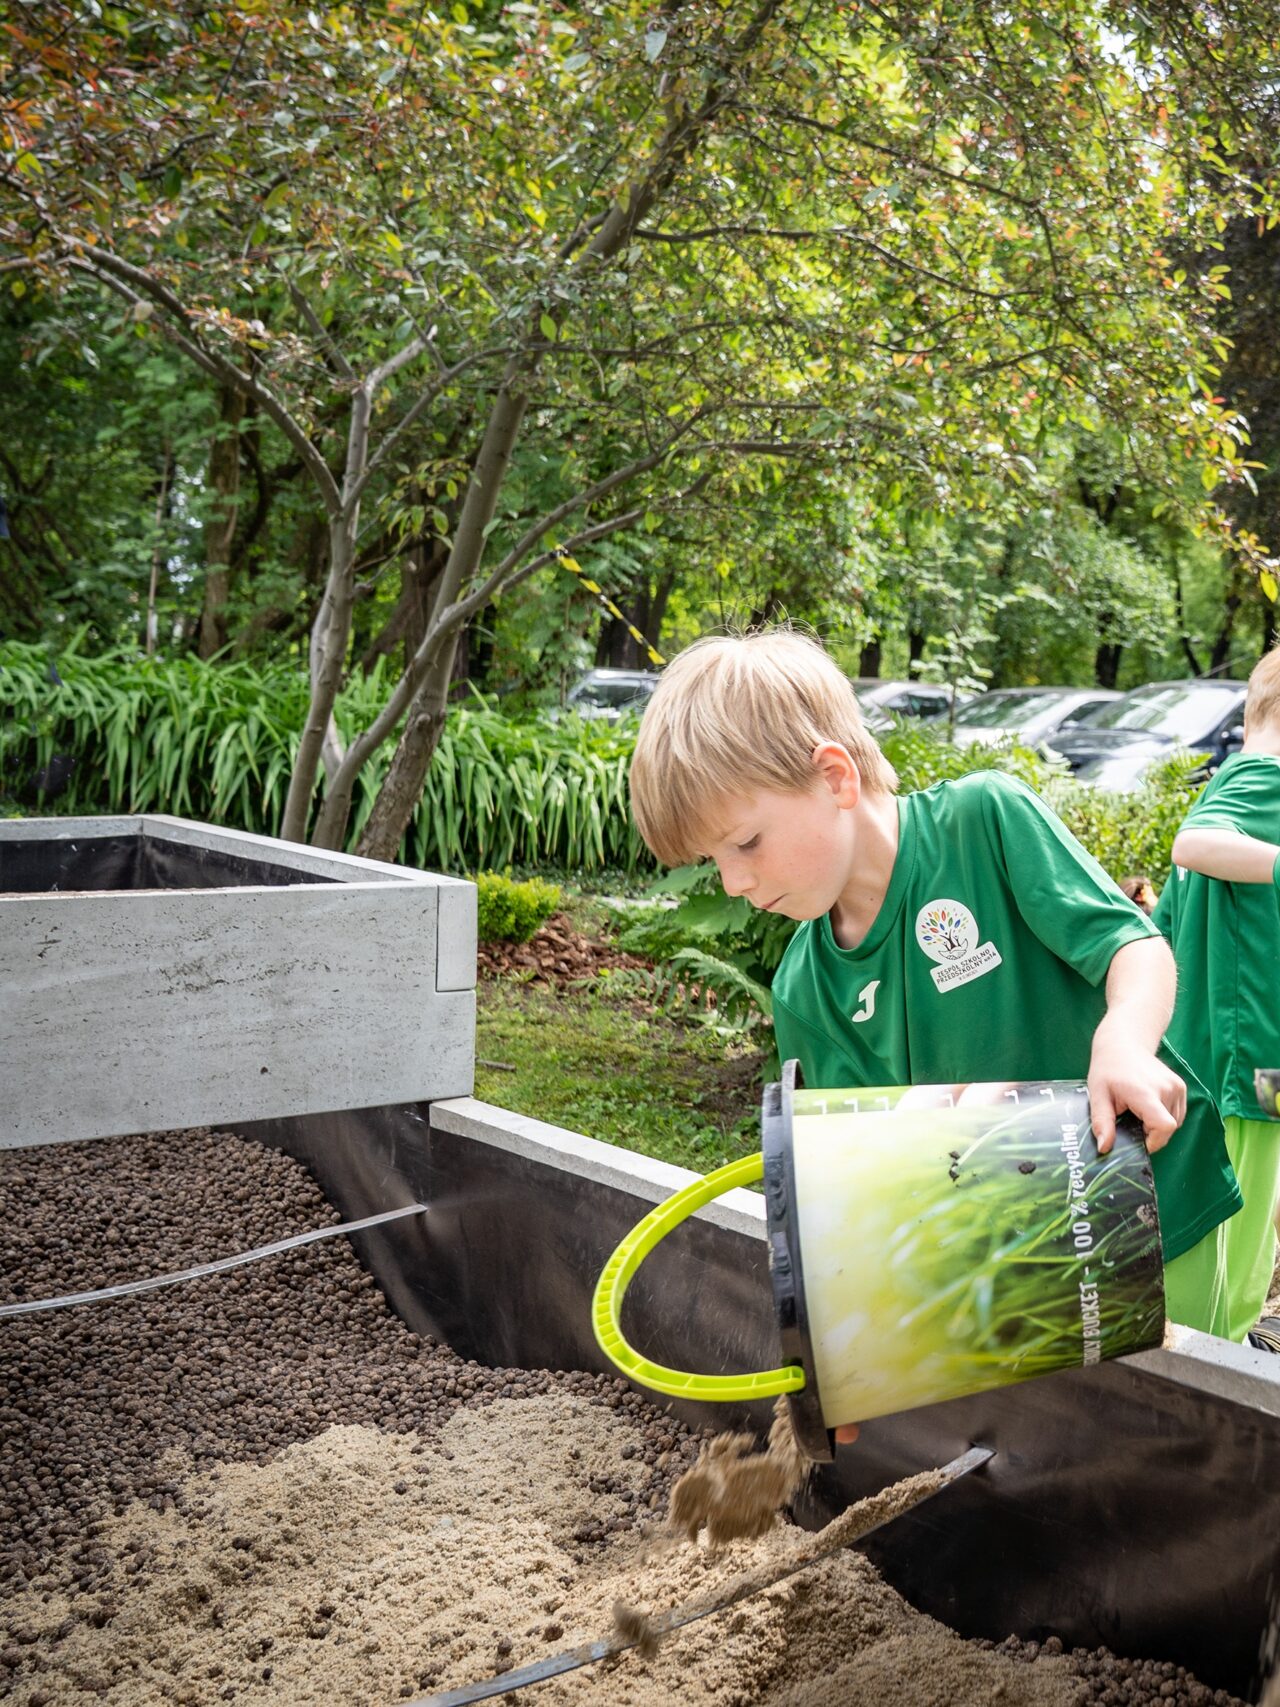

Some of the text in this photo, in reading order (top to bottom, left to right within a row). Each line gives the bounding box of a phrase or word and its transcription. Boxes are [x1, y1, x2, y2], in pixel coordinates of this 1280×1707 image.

[936, 960, 983, 984] PRZEDSZKOLNY
[960, 948, 990, 967] SZKOLNO
[1060, 1123, 1086, 1199] recycling
[1070, 1201, 1089, 1217] %
[1072, 1221, 1094, 1259] 100
[1079, 1281, 1101, 1338] BUCKET
